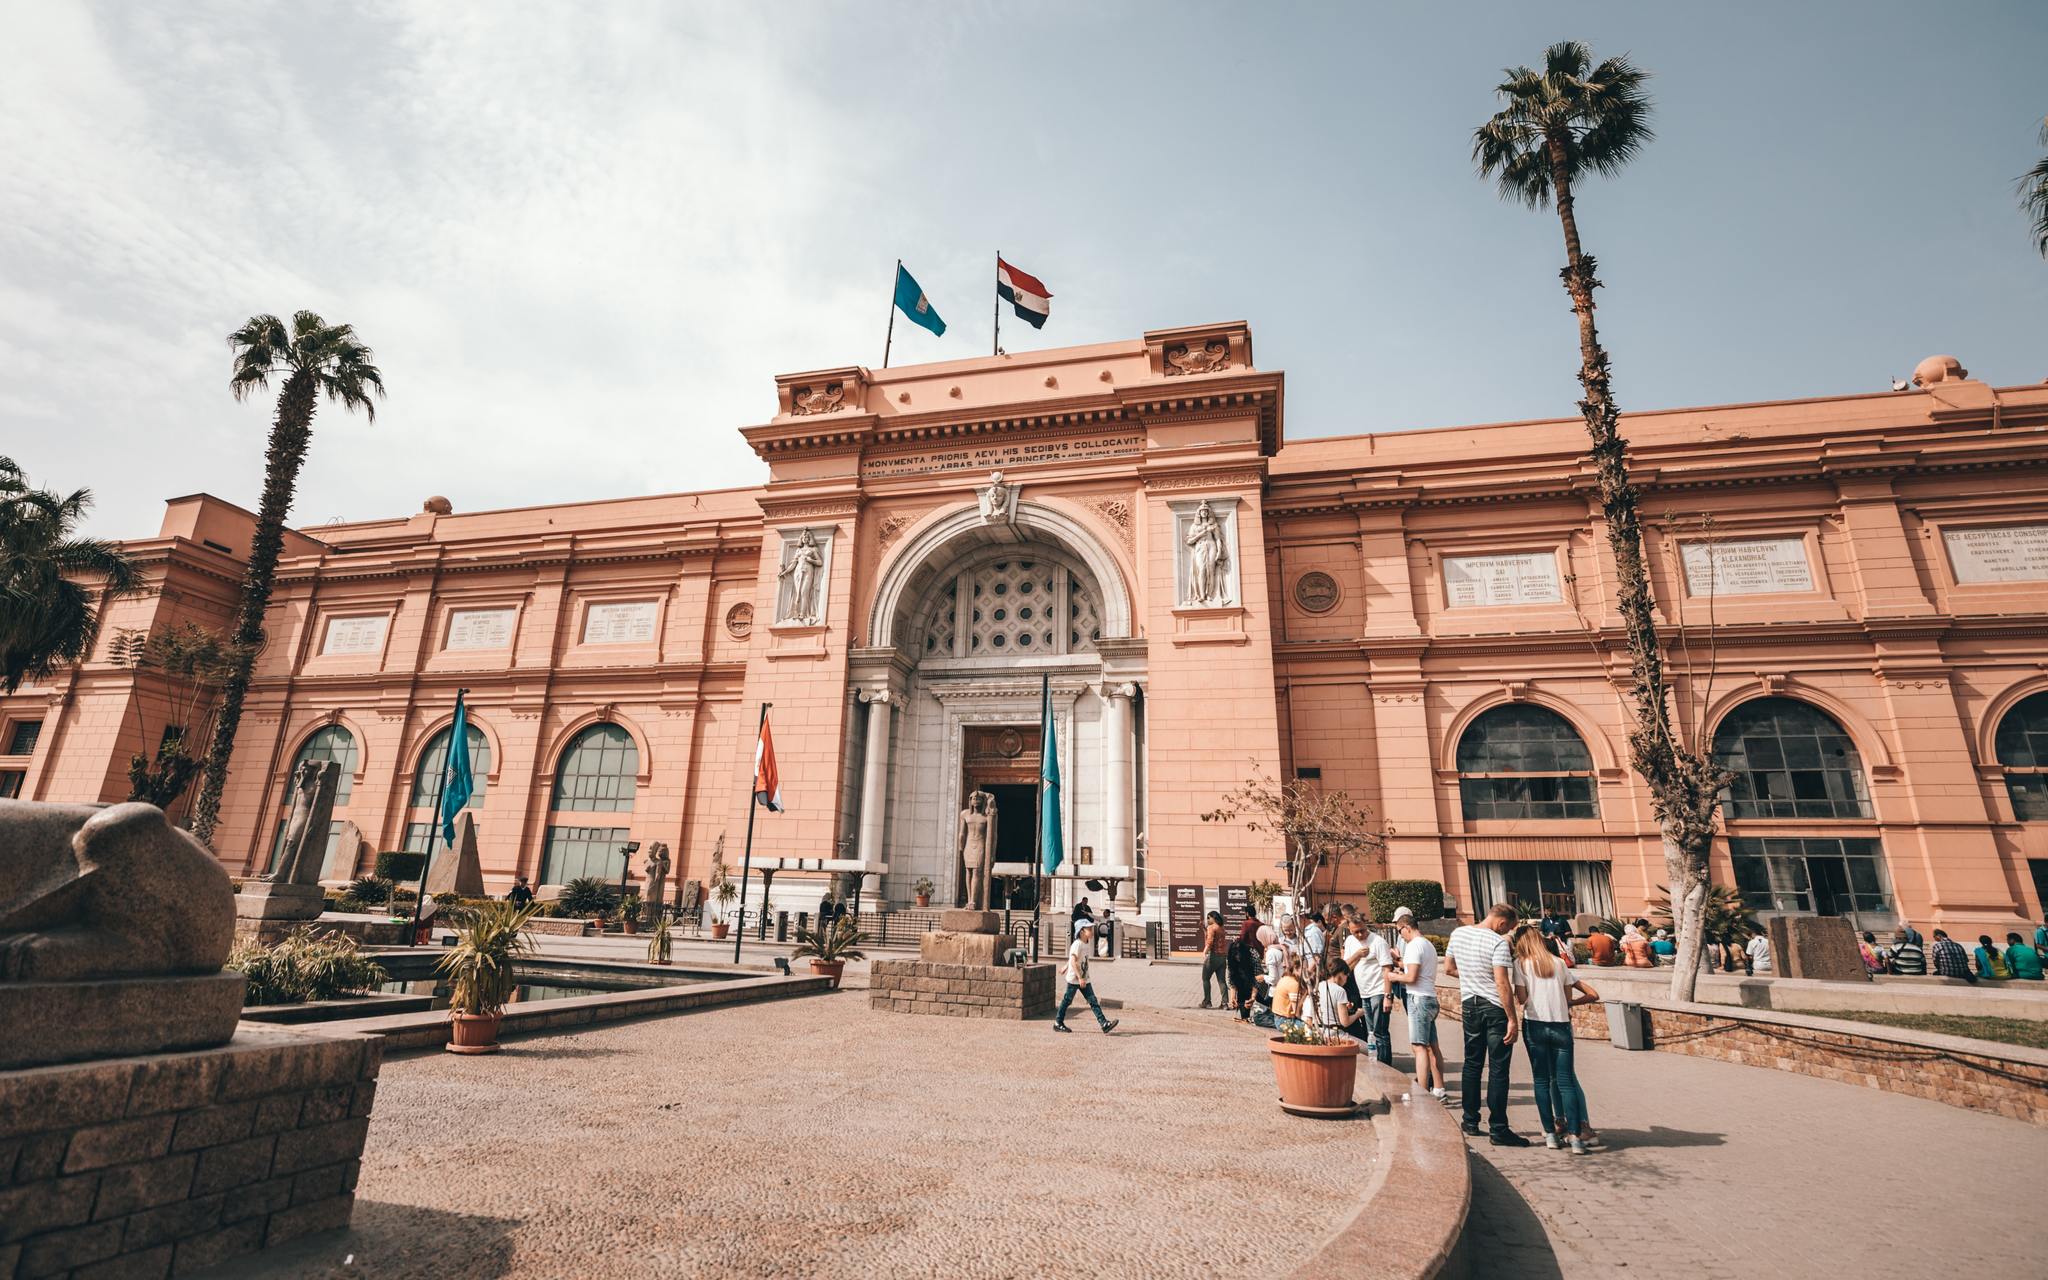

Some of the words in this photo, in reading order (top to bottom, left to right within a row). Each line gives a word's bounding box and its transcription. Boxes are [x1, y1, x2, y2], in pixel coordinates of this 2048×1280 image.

[868, 456, 926, 468] MONVMENTA
[930, 452, 969, 463] PRIORIS
[974, 449, 998, 459] AEVI
[1002, 447, 1019, 456] HIS
[1024, 443, 1069, 454] SEDIBVS
[1073, 436, 1140, 449] COLLOCAVIT
